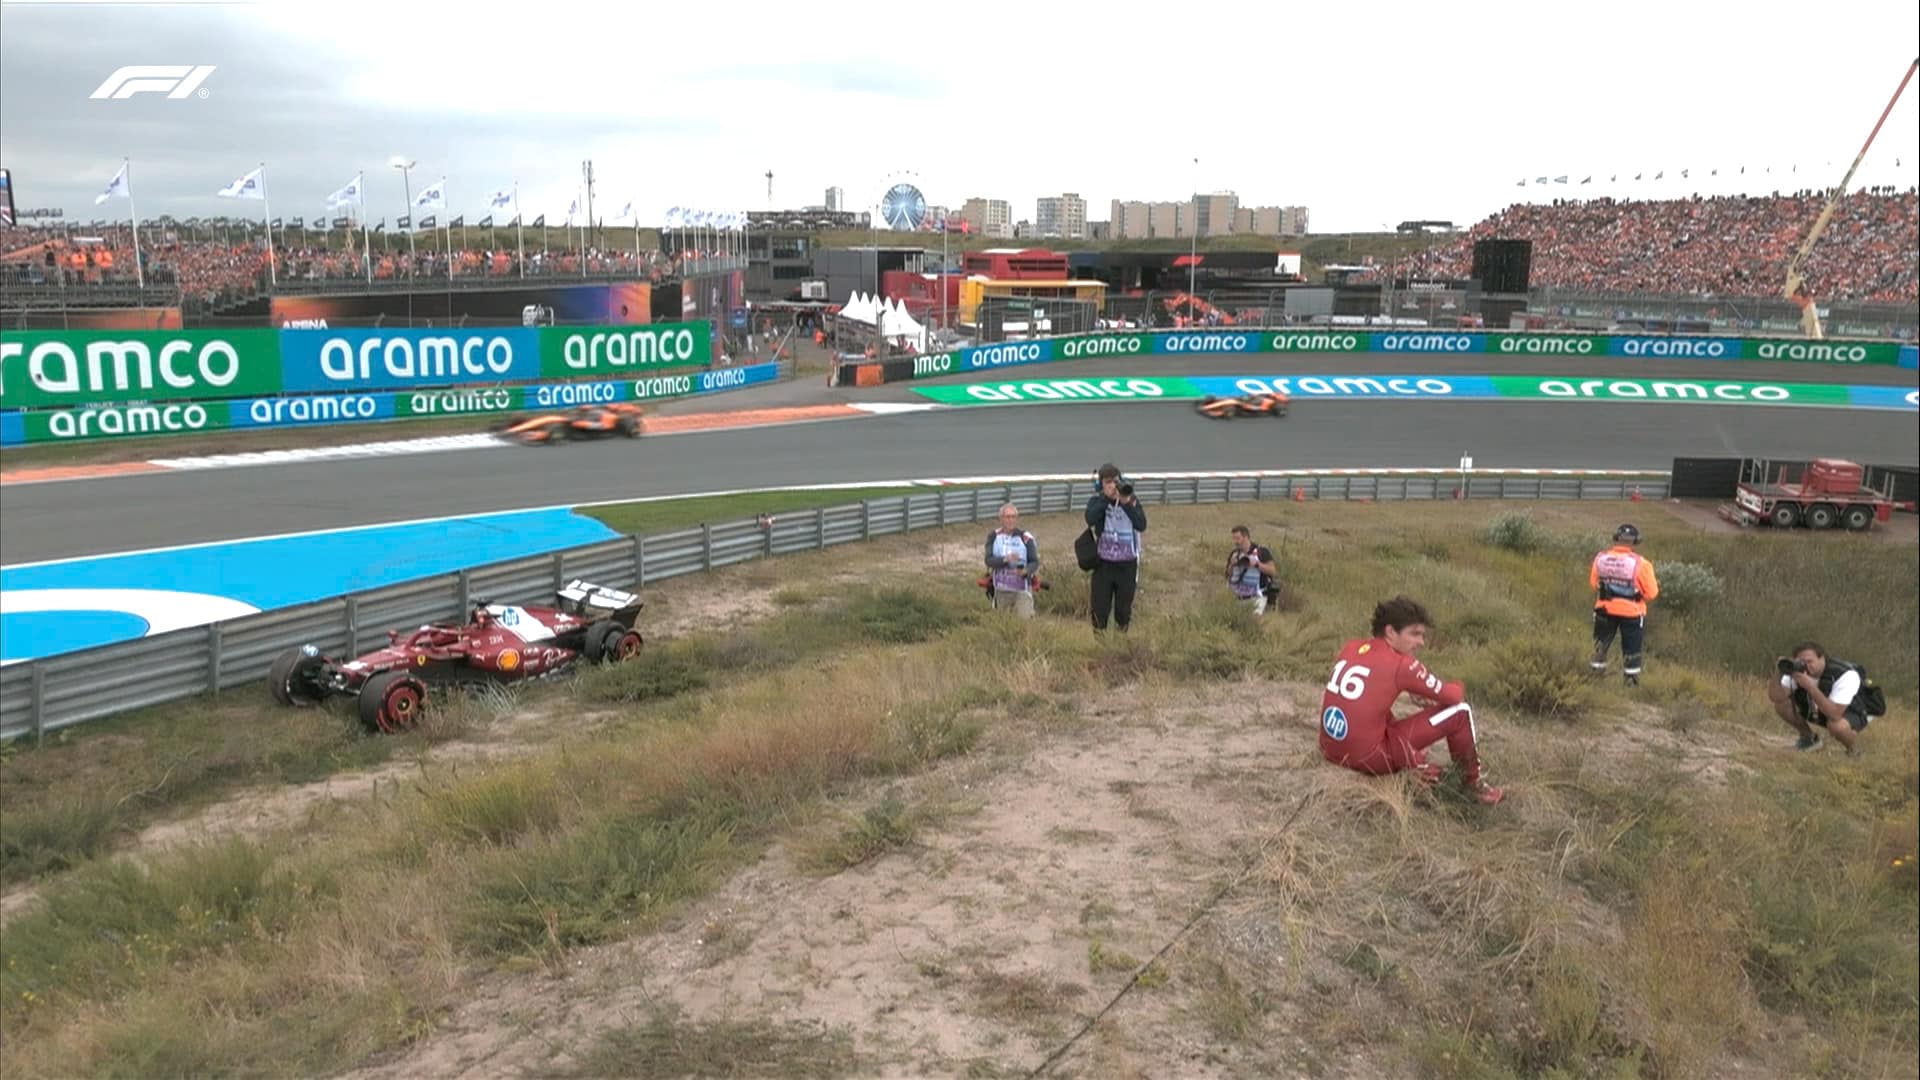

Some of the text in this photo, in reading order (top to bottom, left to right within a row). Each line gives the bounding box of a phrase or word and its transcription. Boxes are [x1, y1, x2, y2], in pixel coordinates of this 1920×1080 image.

[564, 329, 693, 368] aramco
[1063, 337, 1141, 356] aramco
[1166, 335, 1246, 351] aramco
[1272, 335, 1357, 350] aramco
[1383, 336, 1470, 350] aramco
[1500, 338, 1592, 353] aramco
[1624, 340, 1724, 356] aramco
[1758, 344, 1866, 361] aramco
[320, 336, 512, 380] aramco
[913, 353, 951, 374] mco
[971, 343, 1040, 367] aramco
[635, 375, 690, 398] aramco
[703, 368, 745, 389] aramco
[1235, 377, 1452, 395] aramco
[537, 384, 615, 406] aramco
[966, 379, 1163, 400] aramco
[1537, 380, 1790, 401] aramco
[250, 396, 375, 422] aramco
[411, 388, 510, 413] aramco
[49, 404, 207, 437] aramco
[1327, 659, 1371, 700] 16
[1325, 706, 1347, 739] hp
